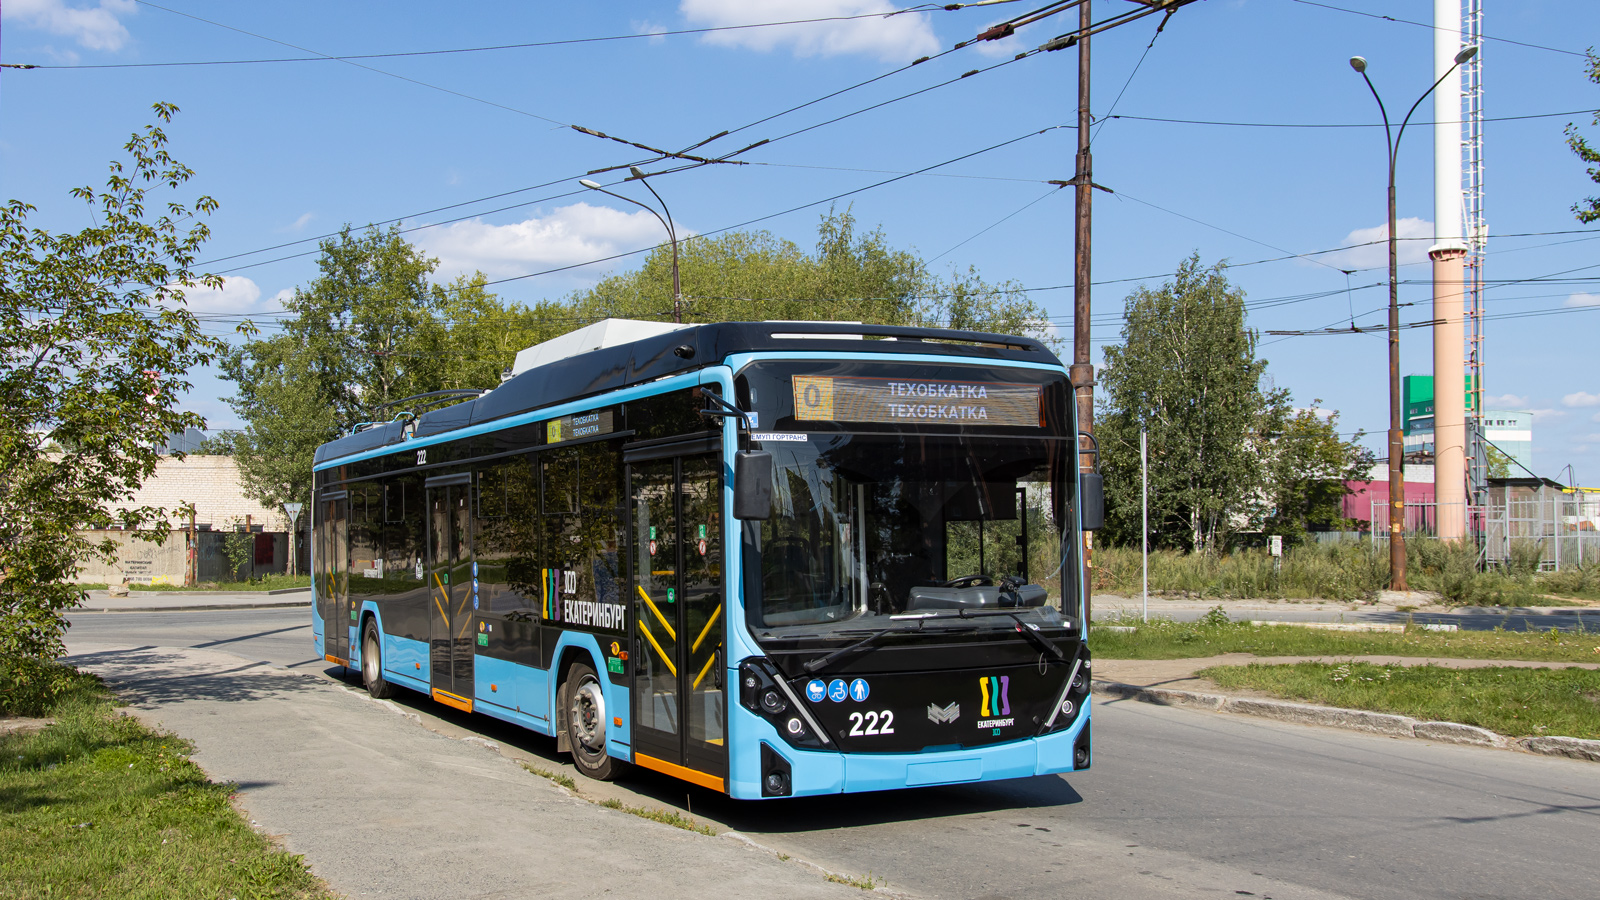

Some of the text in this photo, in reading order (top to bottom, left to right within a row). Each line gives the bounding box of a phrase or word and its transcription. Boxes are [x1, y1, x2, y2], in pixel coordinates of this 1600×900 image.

[804, 384, 820, 408] 0
[887, 382, 988, 399] ТЕХОБКАТКА
[887, 403, 988, 420] ТЕХОБКАТКА
[416, 449, 427, 465] 222
[564, 600, 627, 630] ЕКАТЕРИНБУРГ
[849, 709, 895, 737] 222
[977, 718, 1015, 729] ЕКАТЕРИНБУРГ
